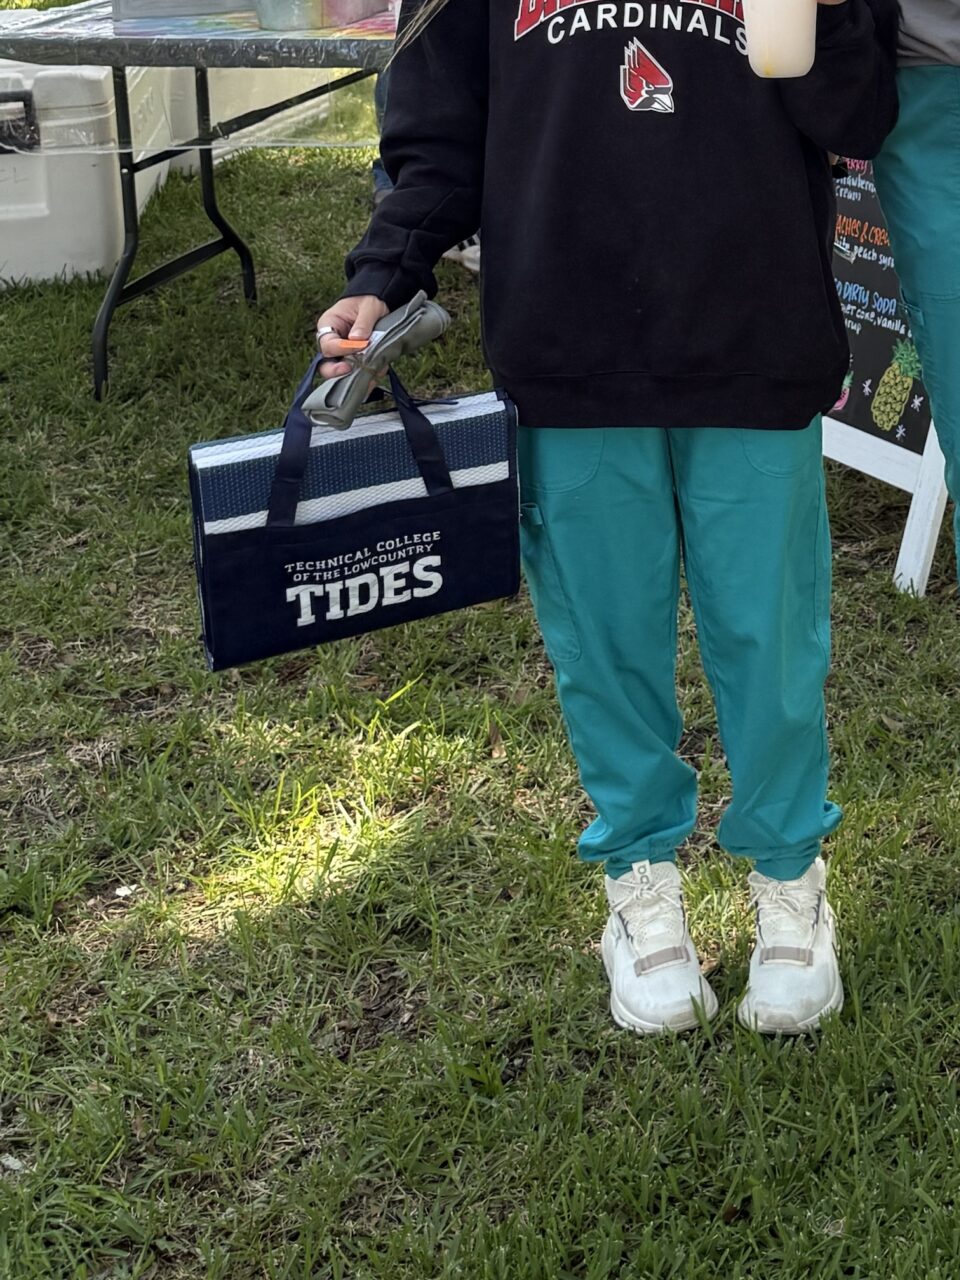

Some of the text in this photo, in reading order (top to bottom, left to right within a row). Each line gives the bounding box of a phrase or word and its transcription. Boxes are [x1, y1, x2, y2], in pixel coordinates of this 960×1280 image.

[547, 2, 749, 56] CARDINALS
[842, 281, 870, 310] DIRTY
[872, 291, 897, 317] SODA
[284, 530, 441, 573] TECHNICAL COLLEGE
[293, 543, 434, 582] OF THE LOWCOUNTRY
[285, 555, 444, 627] TIDES
